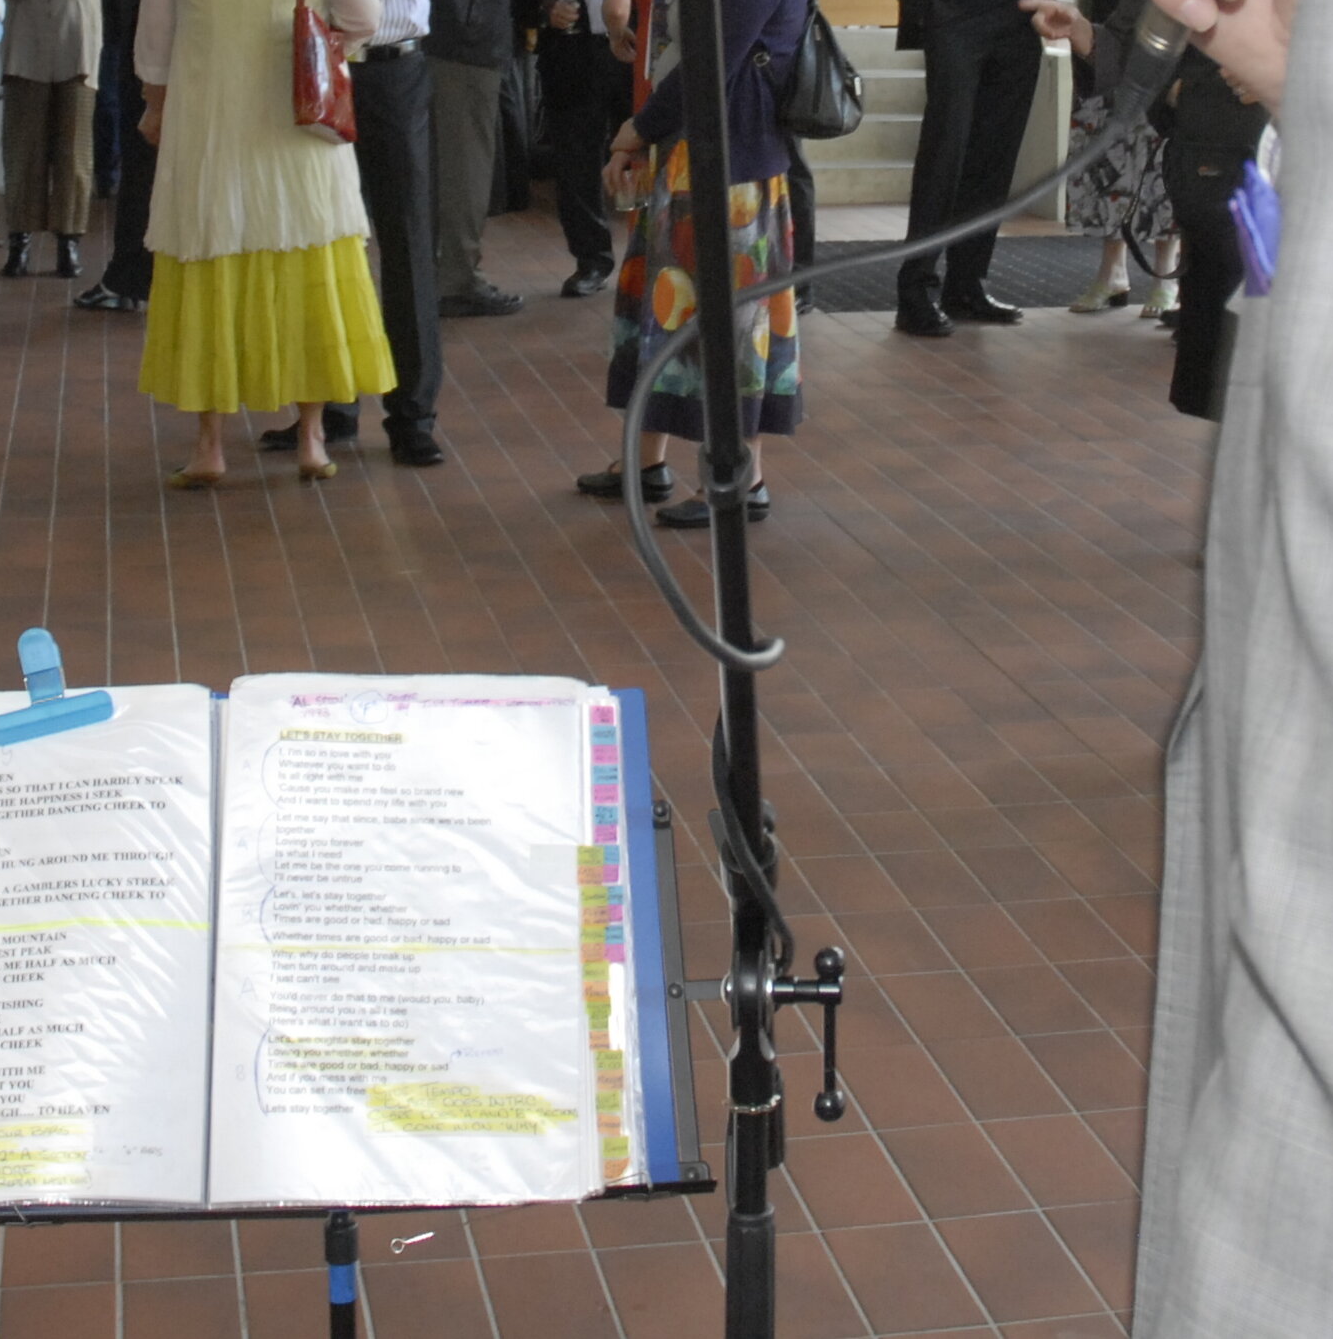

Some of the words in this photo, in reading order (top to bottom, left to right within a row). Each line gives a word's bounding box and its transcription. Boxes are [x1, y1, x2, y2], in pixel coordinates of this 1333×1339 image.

[312, 731, 341, 741] STAY
[343, 733, 403, 743] TOGETHER
[18, 792, 83, 805] HAPPINESS
[91, 788, 122, 799] SEEK
[47, 803, 102, 815] DANCING
[103, 800, 146, 811] CHEEK
[148, 799, 166, 809] TO
[1, 931, 67, 945] MOUNTAIN
[19, 945, 52, 956] PEAK
[3, 960, 22, 971] ME
[24, 958, 57, 969] HALF
[59, 957, 76, 967] AS
[2, 971, 45, 983] CHEEK
[27, 1025, 43, 1035] AS
[45, 1022, 84, 1034] MUCH
[0, 1038, 43, 1050] CHEEK
[26, 1064, 46, 1075] ME
[8, 1078, 35, 1090] YOU
[36, 1106, 55, 1116] TO
